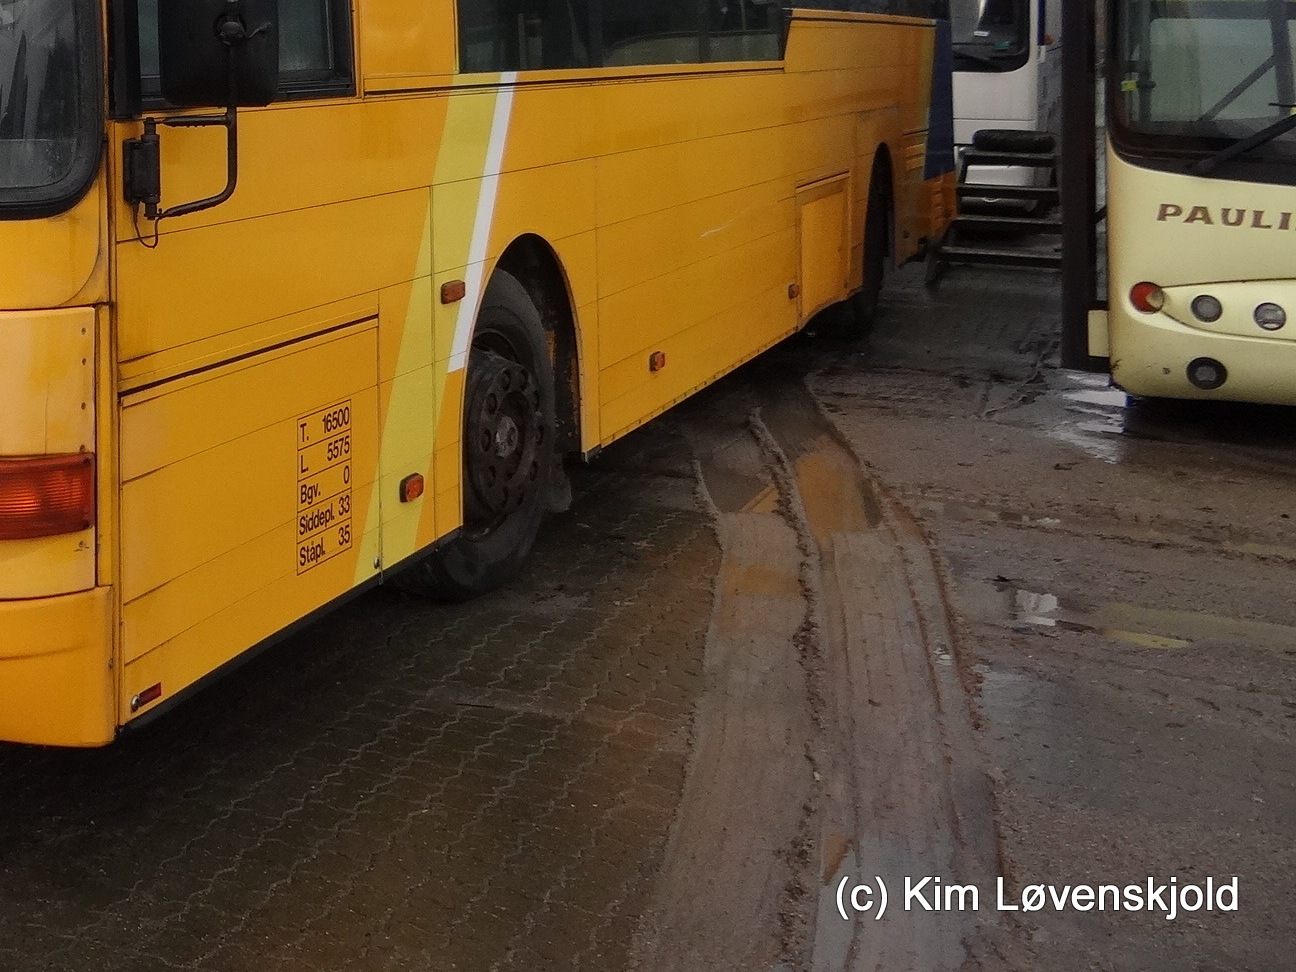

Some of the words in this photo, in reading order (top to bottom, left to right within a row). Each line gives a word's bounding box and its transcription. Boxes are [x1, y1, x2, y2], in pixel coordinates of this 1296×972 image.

[1156, 203, 1296, 231] PAULI
[300, 423, 309, 441] T.
[322, 406, 350, 434] 16500
[301, 455, 309, 473] L.
[327, 435, 350, 461] 5575
[300, 483, 321, 505] Bgv.
[344, 465, 350, 484] 0
[299, 503, 335, 535] Siddepl.
[338, 495, 351, 516] 33
[299, 537, 326, 566] Ståpl.
[338, 524, 351, 546] 35
